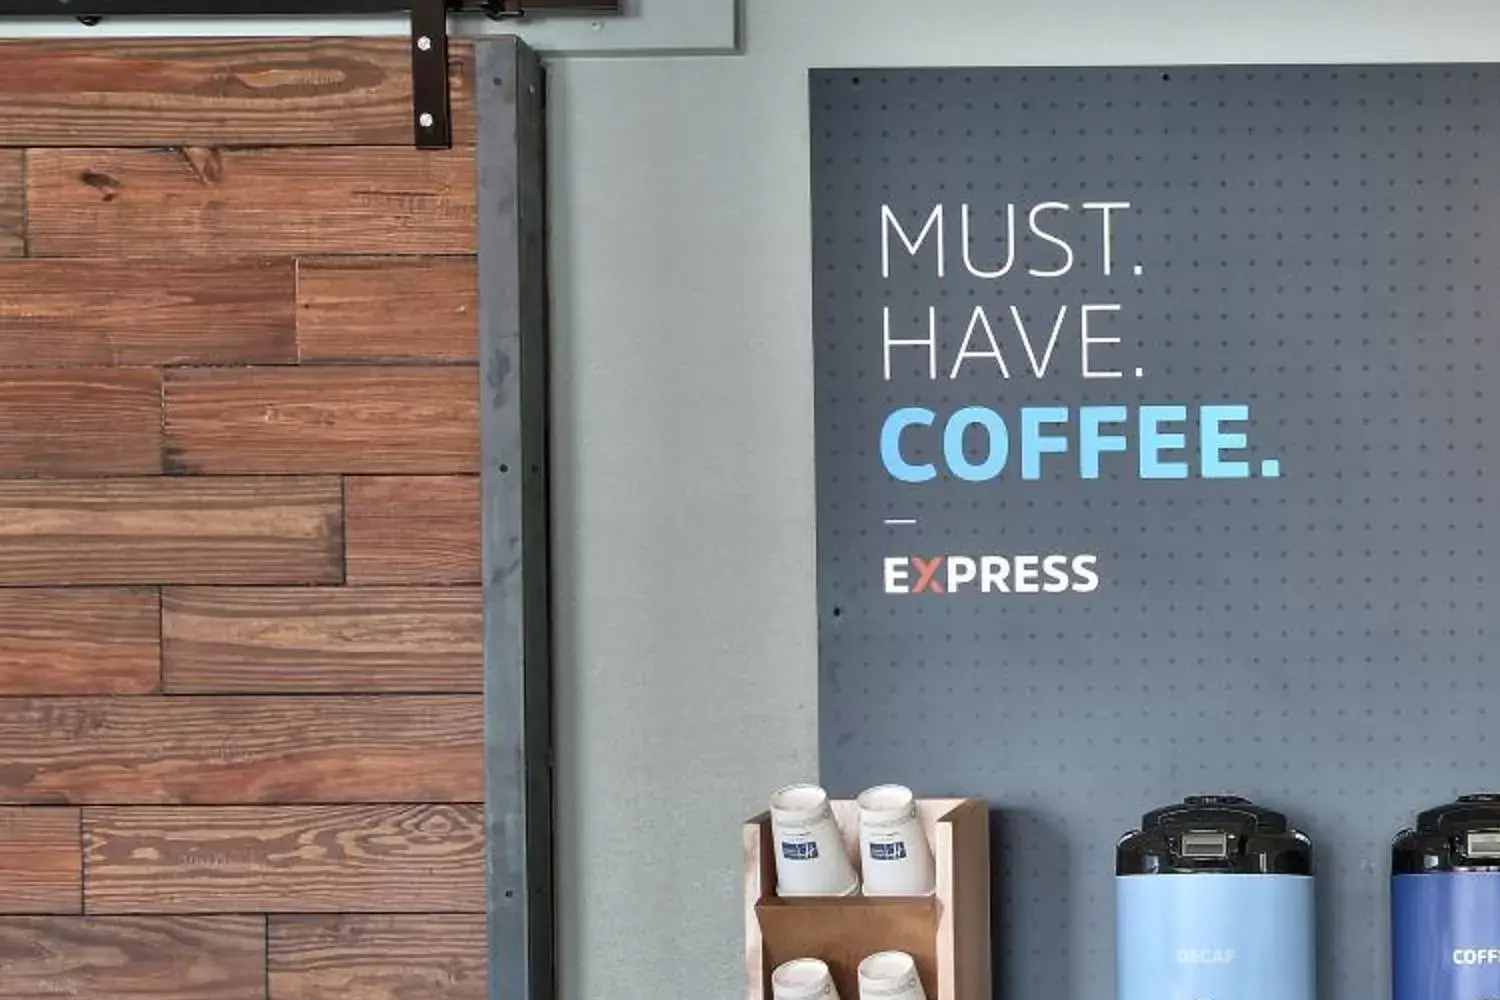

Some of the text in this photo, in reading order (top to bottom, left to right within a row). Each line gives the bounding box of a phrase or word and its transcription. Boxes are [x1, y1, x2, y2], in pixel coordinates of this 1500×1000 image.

[880, 200, 1144, 279] MUST.
[882, 303, 1145, 381] HAVE.
[879, 403, 1281, 484] COFFEE.
[883, 554, 1100, 594] EXPRESS
[1176, 948, 1236, 965] DECAF
